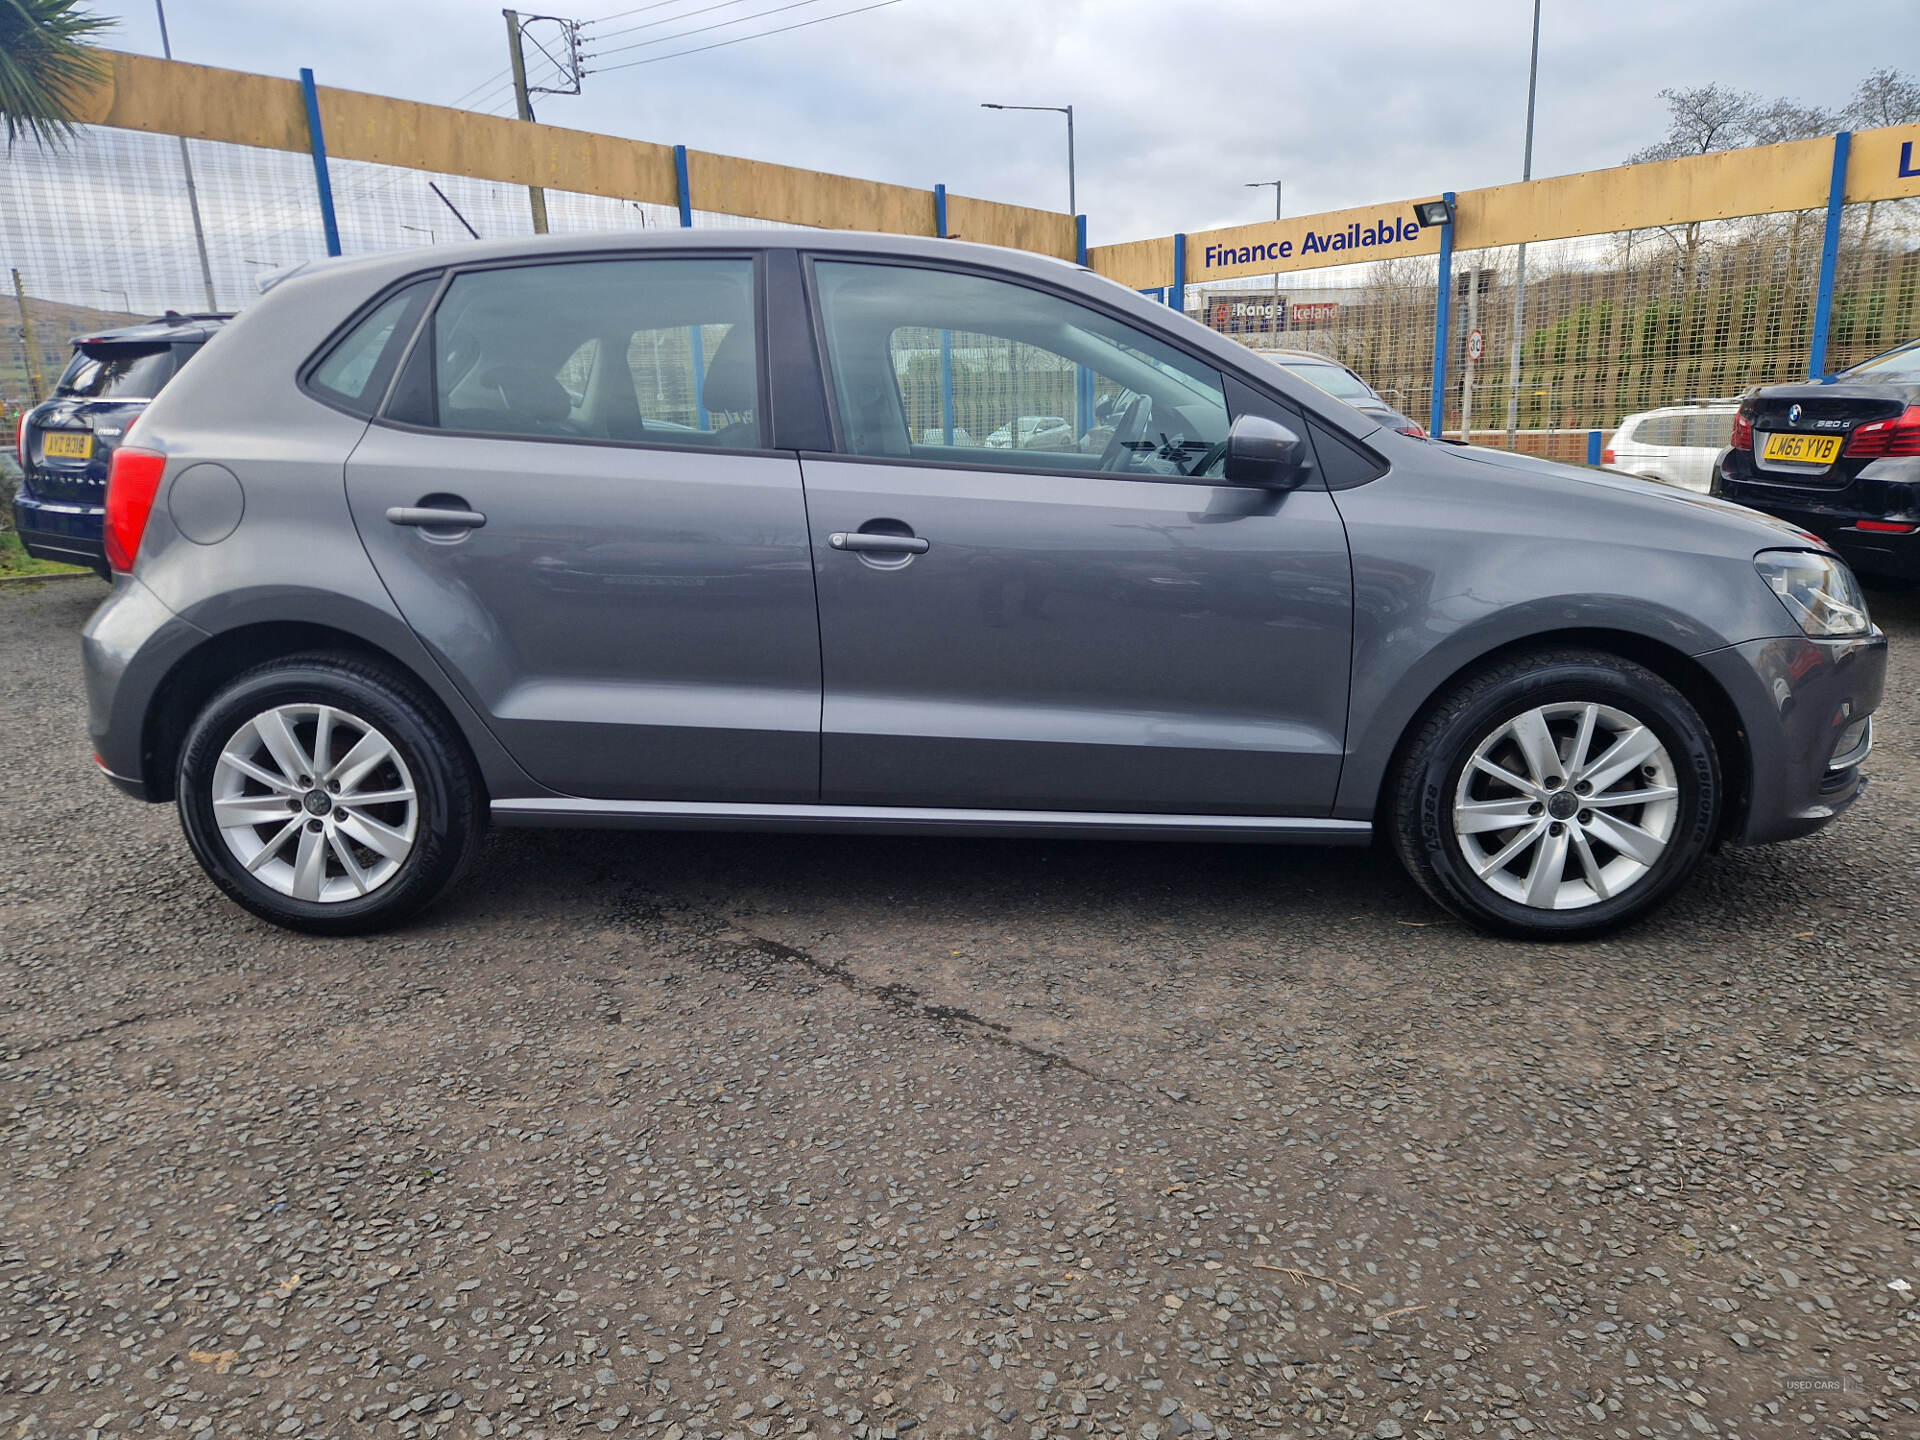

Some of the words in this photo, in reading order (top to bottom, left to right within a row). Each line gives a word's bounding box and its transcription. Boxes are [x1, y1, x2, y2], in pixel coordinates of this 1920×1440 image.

[1205, 240, 1293, 268] Finance
[1301, 217, 1420, 255] Available
[1236, 303, 1284, 319] Range
[1292, 305, 1338, 320] Iceland
[1470, 338, 1481, 352] 30
[1769, 437, 1804, 456] LM66
[1806, 439, 1834, 458] YVB
